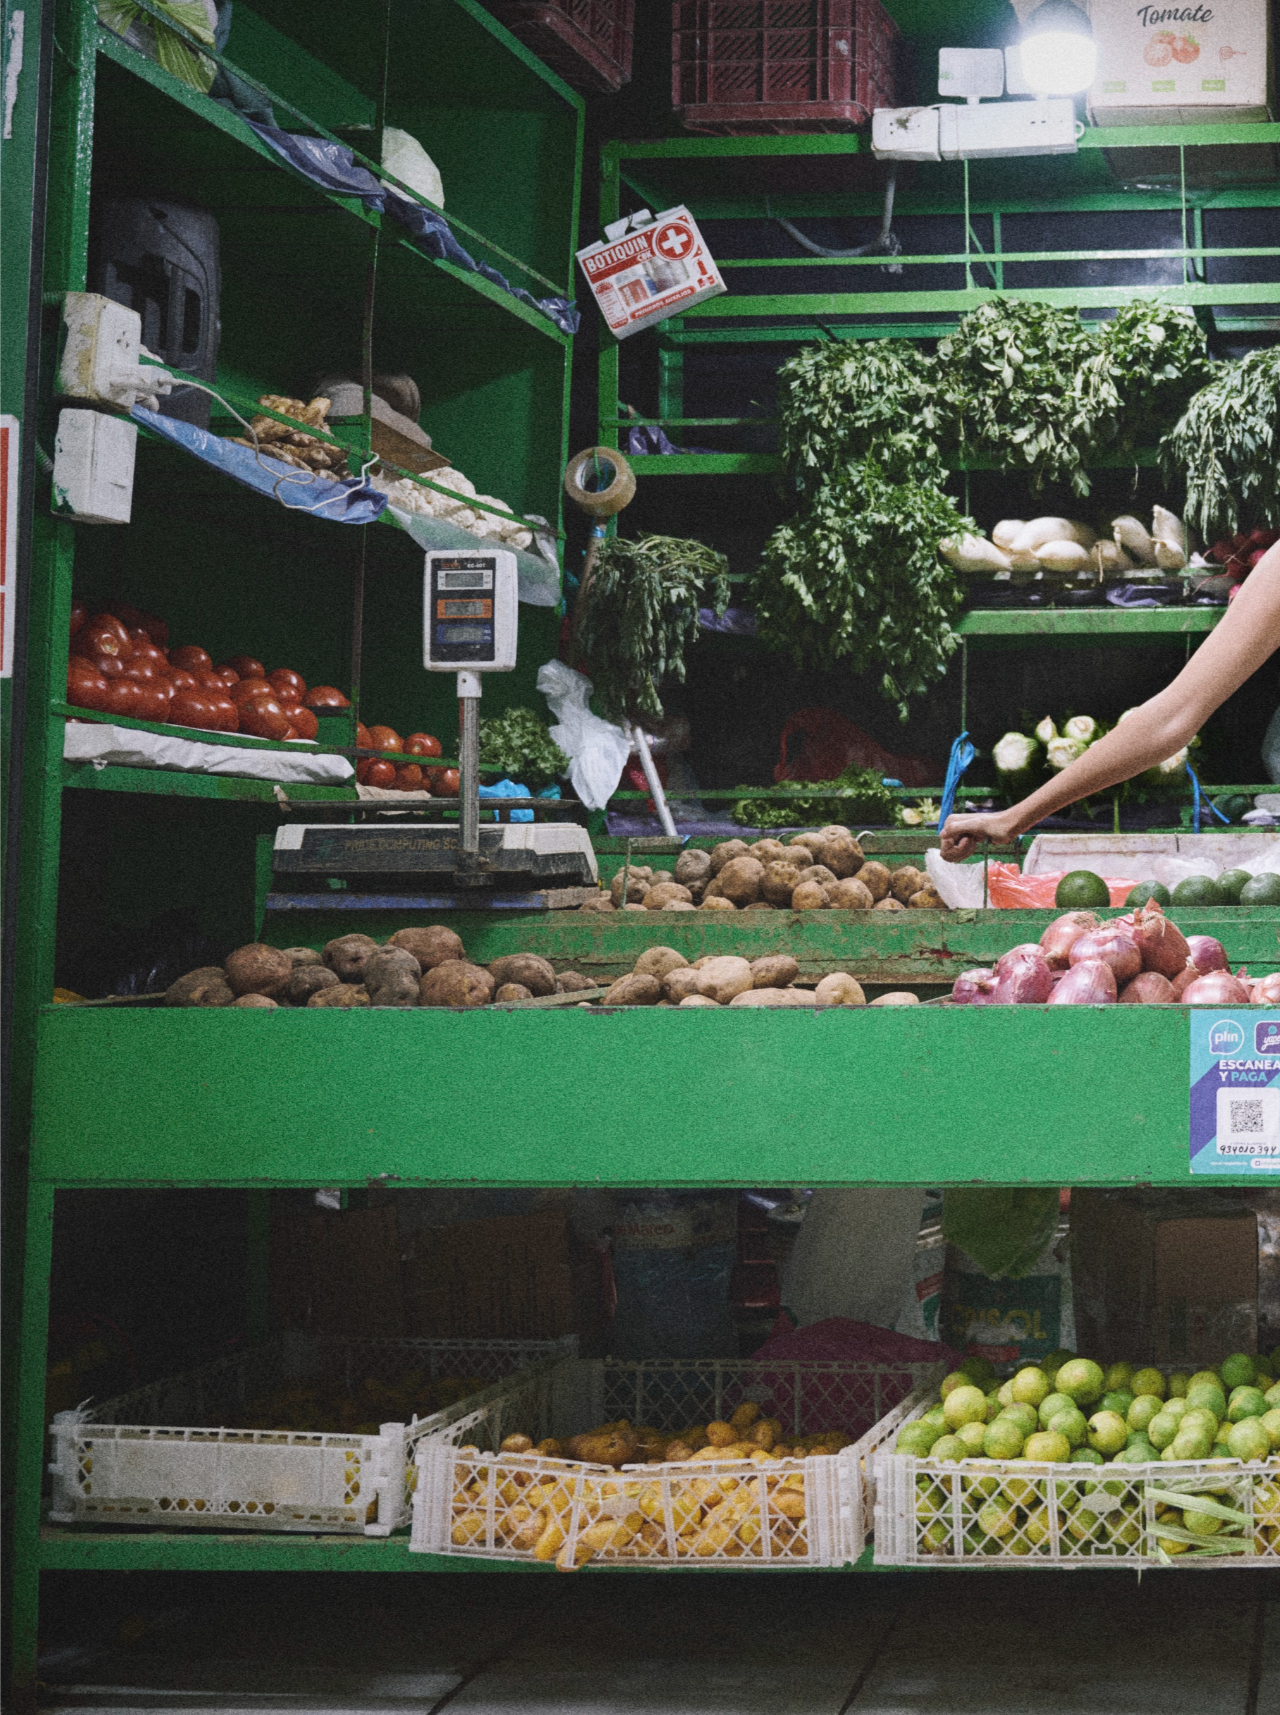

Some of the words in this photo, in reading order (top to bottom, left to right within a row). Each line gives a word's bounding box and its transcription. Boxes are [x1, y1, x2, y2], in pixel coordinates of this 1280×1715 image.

[1137, 4, 1214, 28] Tomate
[585, 236, 649, 274] BOTIQUIN
[1214, 1033, 1239, 1044] plin
[1219, 1072, 1228, 1082] Y
[1231, 1072, 1268, 1082] PAGA
